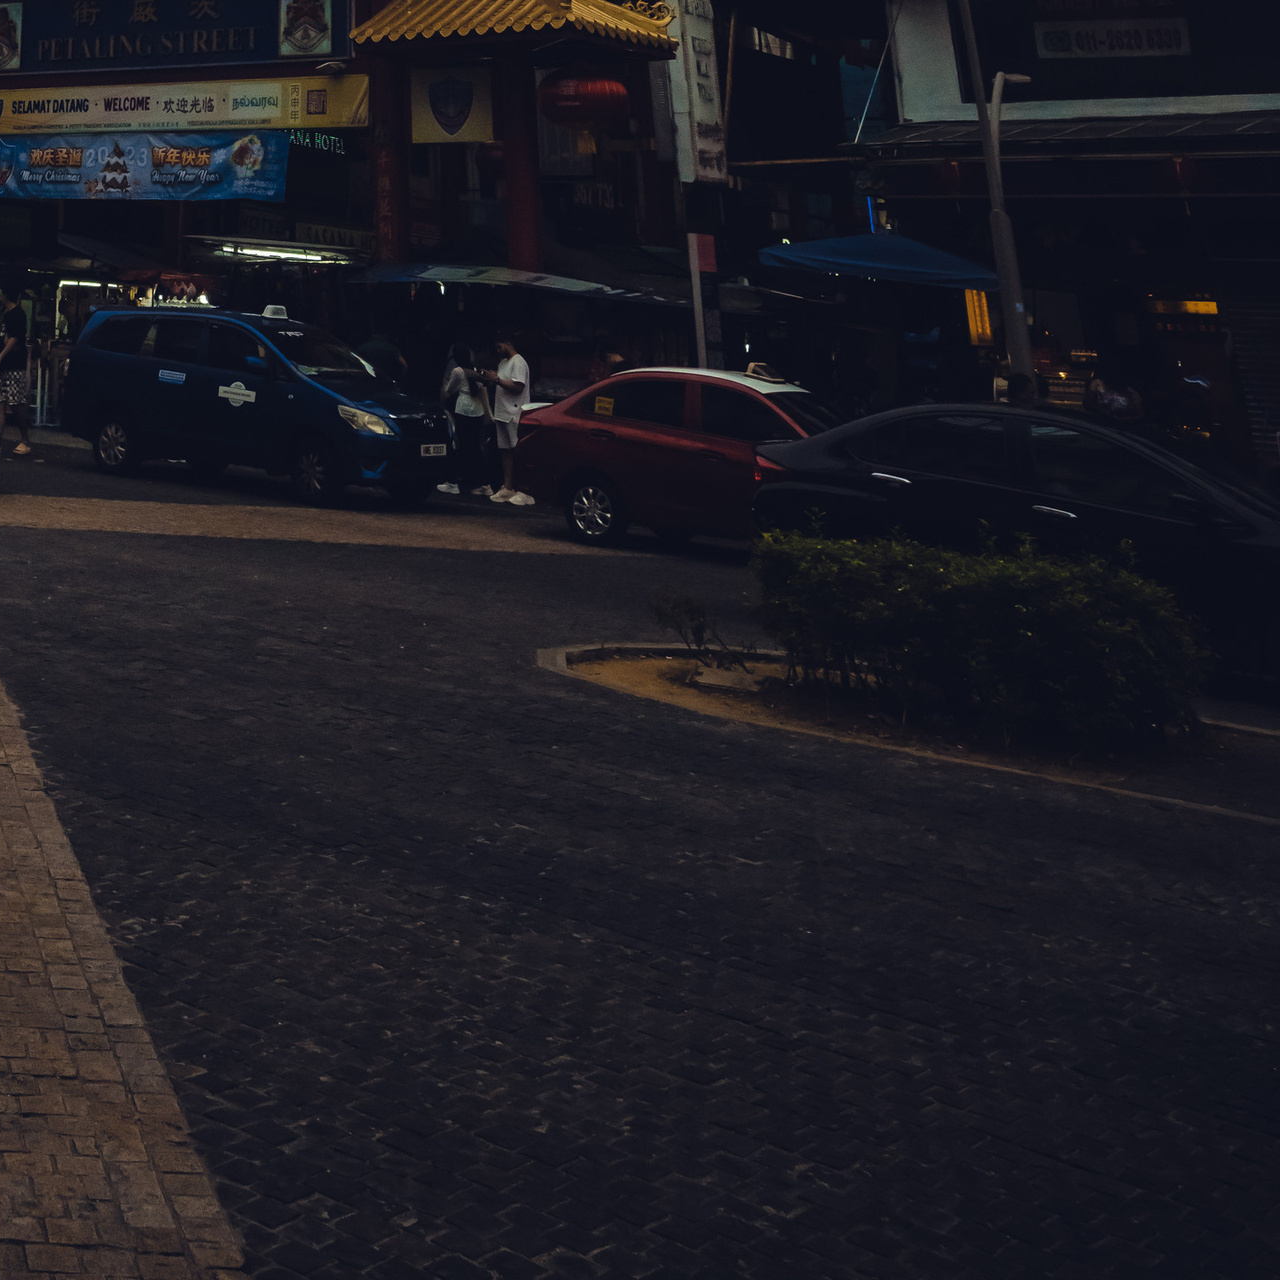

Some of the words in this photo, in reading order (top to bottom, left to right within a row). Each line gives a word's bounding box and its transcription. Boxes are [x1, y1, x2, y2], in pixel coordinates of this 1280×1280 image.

[36, 32, 154, 63] PETALING
[160, 25, 261, 58] STREET
[11, 98, 51, 115] SELAMAT
[52, 98, 89, 113] DATANG
[103, 96, 150, 112] WELCOME
[162, 95, 215, 114] 欢迎光临
[314, 131, 346, 155] HOTEL
[151, 146, 212, 168] 新年快乐
[20, 169, 43, 184] Merry
[44, 170, 81, 183] Christmas
[151, 169, 176, 184] Happy
[176, 169, 196, 183] New
[196, 169, 220, 184] Year
